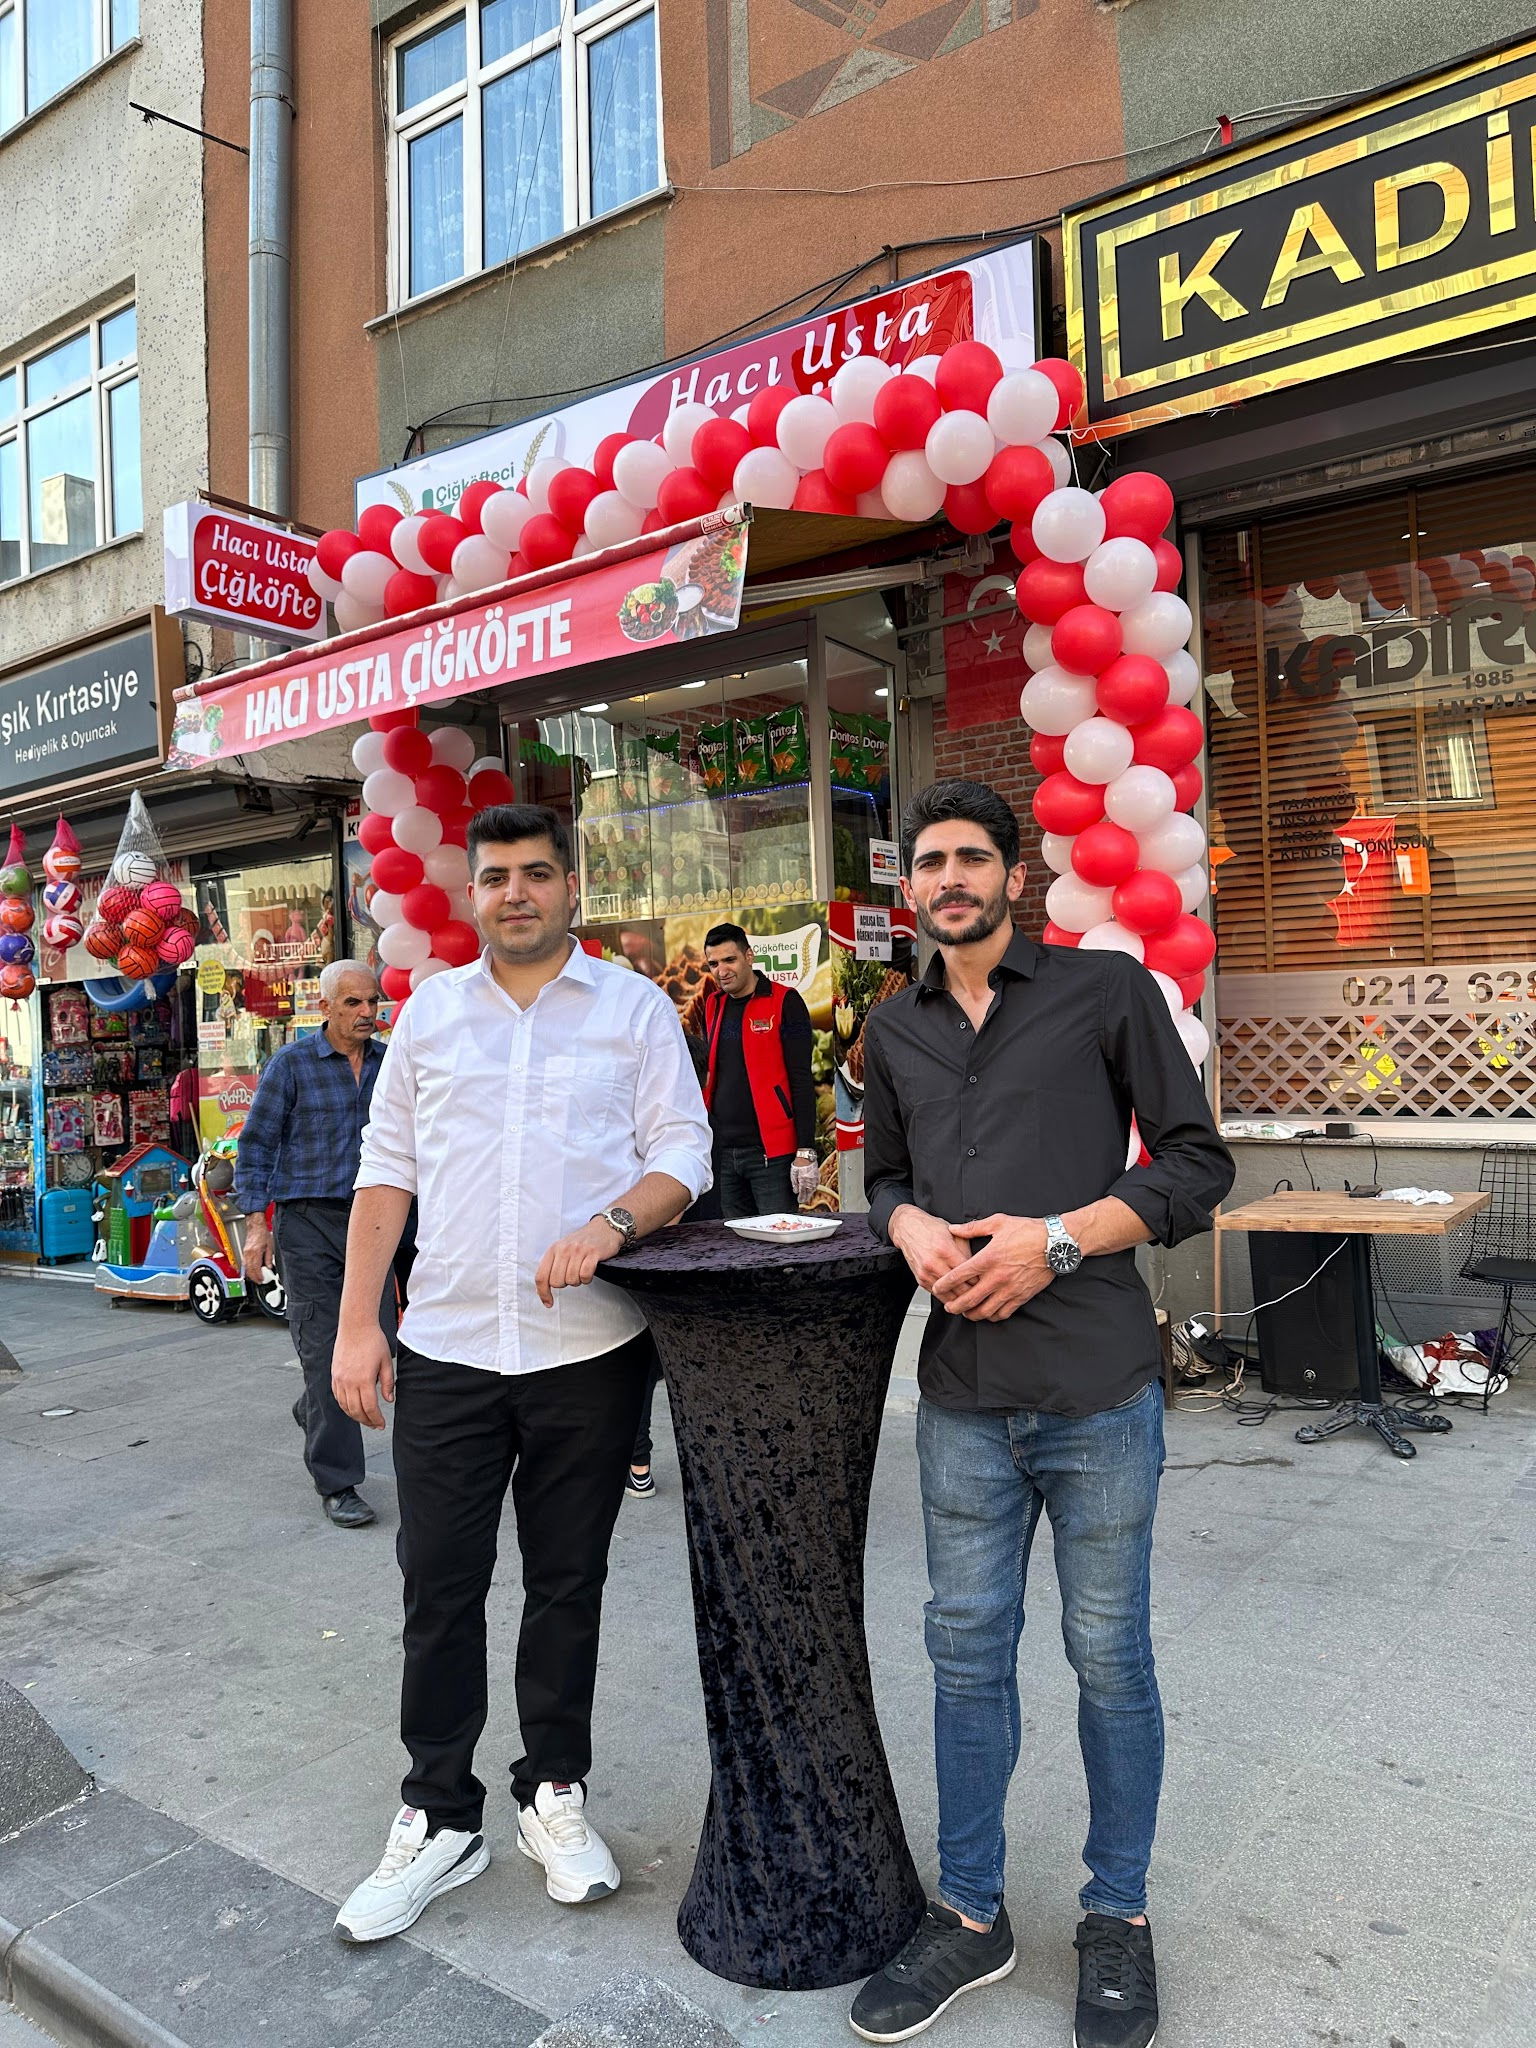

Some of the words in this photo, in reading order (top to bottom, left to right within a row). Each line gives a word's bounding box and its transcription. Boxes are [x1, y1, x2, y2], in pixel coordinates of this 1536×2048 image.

[1159, 110, 1536, 342] KADİ
[668, 355, 782, 416] Hacı
[802, 301, 934, 376] Usta
[212, 523, 261, 561] Hacı
[265, 540, 310, 576] Usta
[200, 558, 317, 620] Çiğköfte
[245, 677, 310, 740] HACI
[316, 652, 393, 720] USTA
[400, 598, 573, 707] ÇİĞKÖFTE
[1462, 669, 1514, 690] 1985
[0, 700, 31, 746] şık
[36, 670, 139, 727] Kırtasiye
[15, 737, 59, 765] Hediyelik
[61, 734, 69, 751] &
[71, 720, 118, 750] Oyuncak
[830, 728, 859, 745] Doritos
[1354, 834, 1436, 854] DÖNÜŞÜM
[753, 942, 798, 954] Çiğköfteci
[772, 972, 799, 982] USTA
[1342, 973, 1451, 1007] 0212
[219, 1087, 252, 1110] Play-Do
